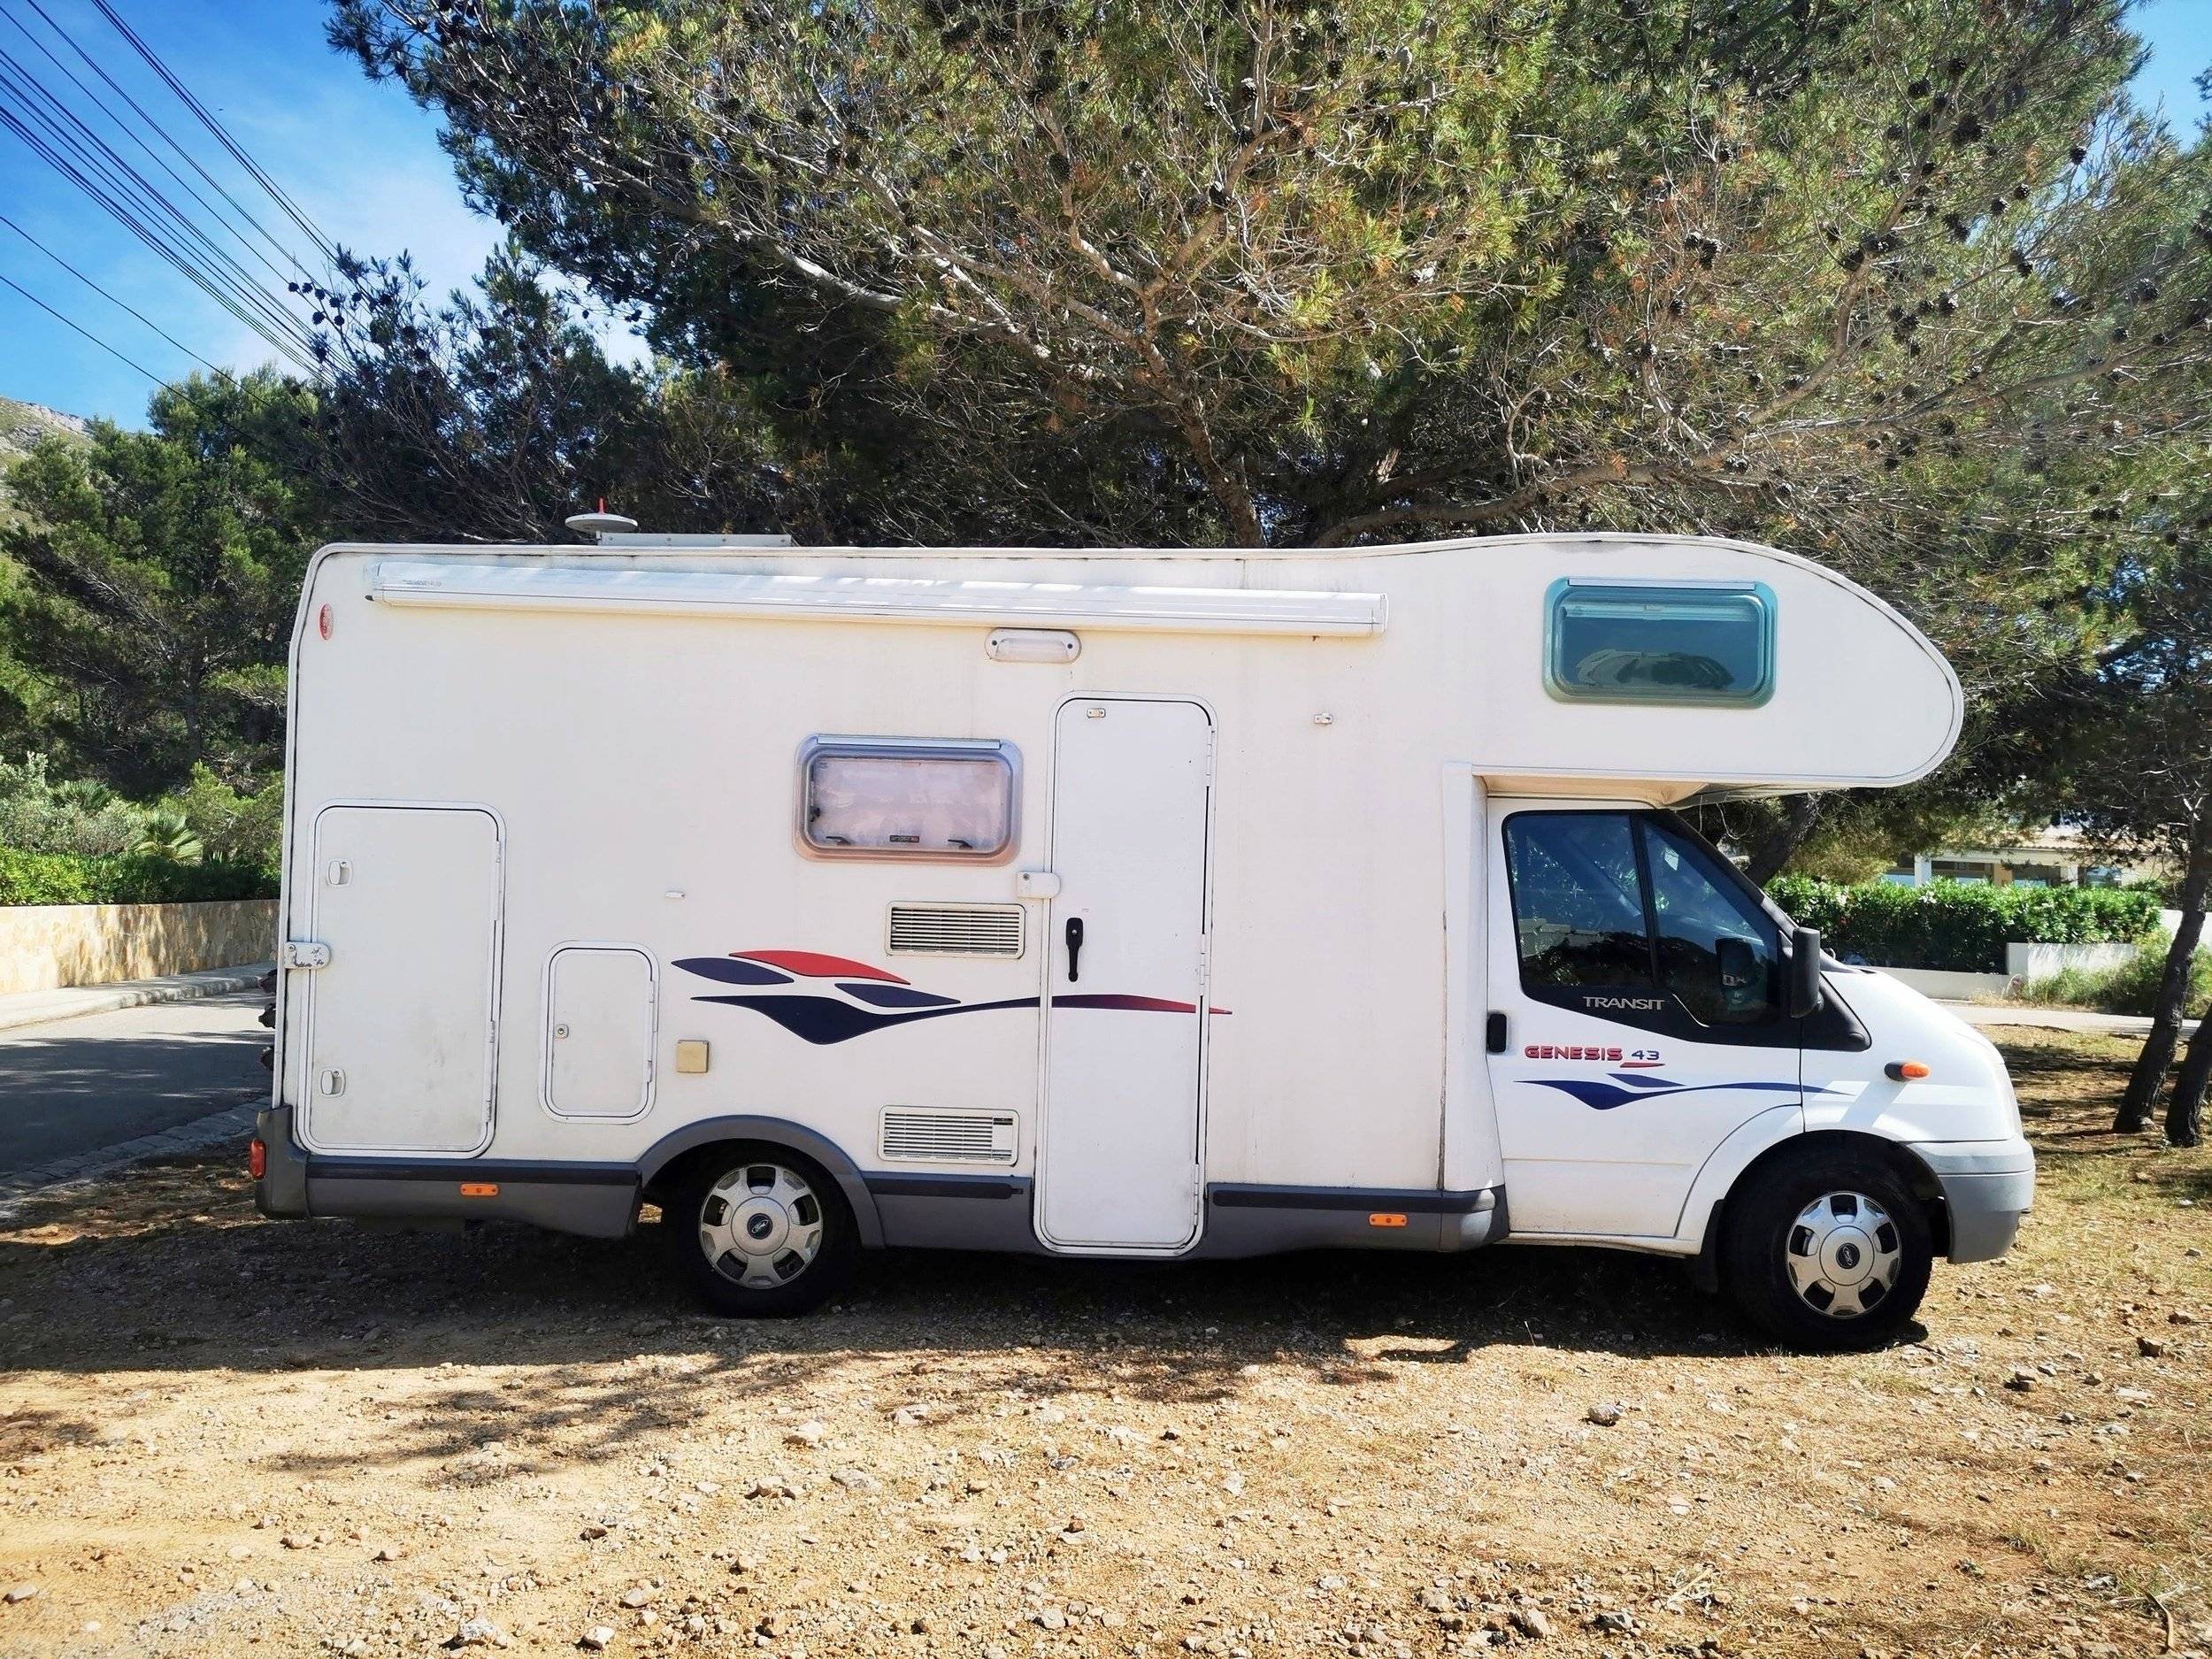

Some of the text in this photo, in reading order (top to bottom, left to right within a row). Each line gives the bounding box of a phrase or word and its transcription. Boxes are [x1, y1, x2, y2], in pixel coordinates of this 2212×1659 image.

[1583, 996, 1665, 1010] TRANSIT
[1525, 1046, 1660, 1061] GENESIS 43
